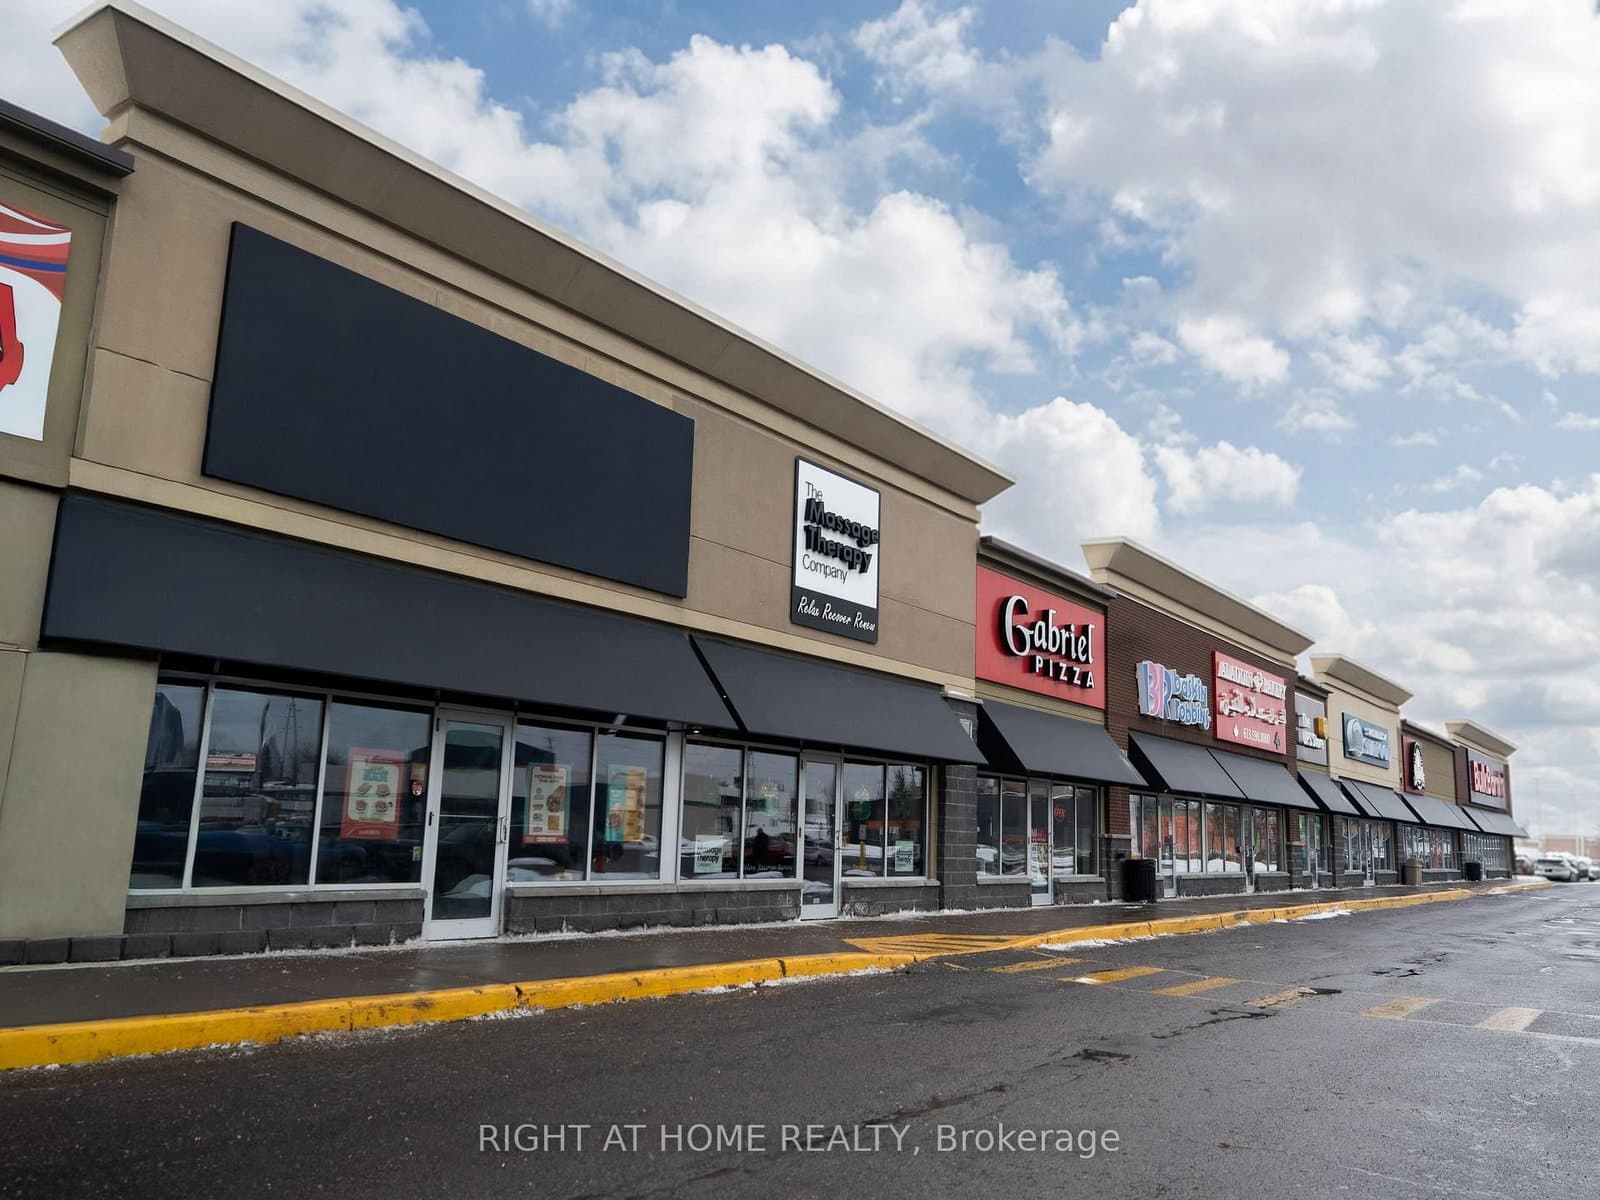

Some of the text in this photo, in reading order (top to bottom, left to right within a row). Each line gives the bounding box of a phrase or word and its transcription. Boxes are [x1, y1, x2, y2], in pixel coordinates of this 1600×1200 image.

[805, 481, 823, 501] The
[804, 498, 880, 548] Massage
[804, 524, 873, 574] Therapy
[802, 553, 848, 584] Company
[797, 596, 876, 632] Relax Recover Renew
[1002, 595, 1096, 665] Gabriel
[1033, 655, 1095, 688] PIZZA
